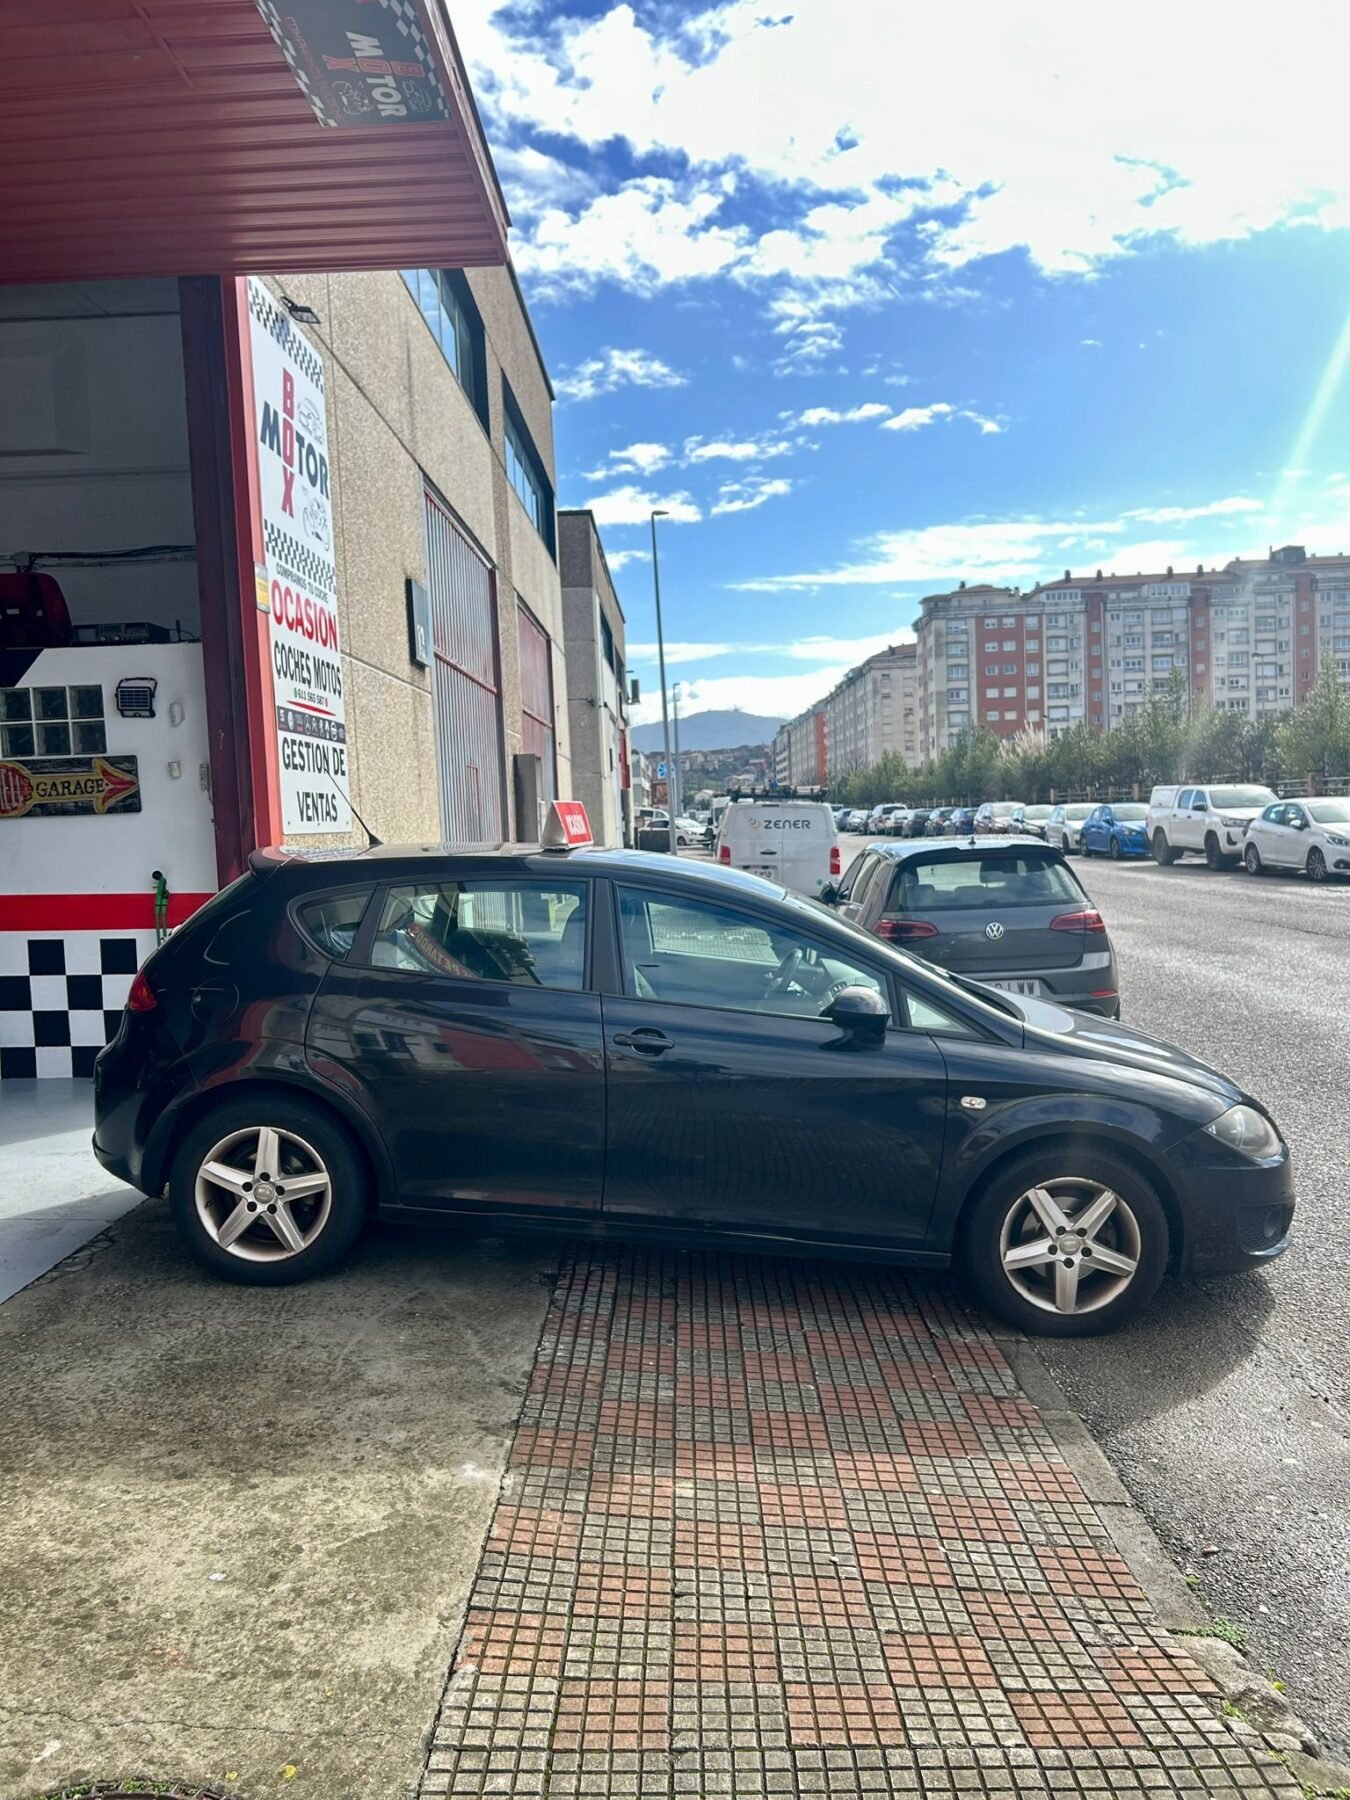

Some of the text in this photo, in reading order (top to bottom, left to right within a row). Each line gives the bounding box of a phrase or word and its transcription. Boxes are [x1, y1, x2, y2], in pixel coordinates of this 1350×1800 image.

[322, 54, 425, 78] BOX
[345, 31, 407, 117] MOTOR
[260, 400, 329, 501] MOTOR
[282, 367, 295, 519] BOX
[271, 579, 338, 652] OCASION
[273, 640, 342, 699] COCHES MOTOS
[282, 736, 346, 777] GESTION DE
[36, 779, 106, 798] GARAGE
[296, 791, 338, 822] VENTAS
[764, 819, 811, 829] ZENER
